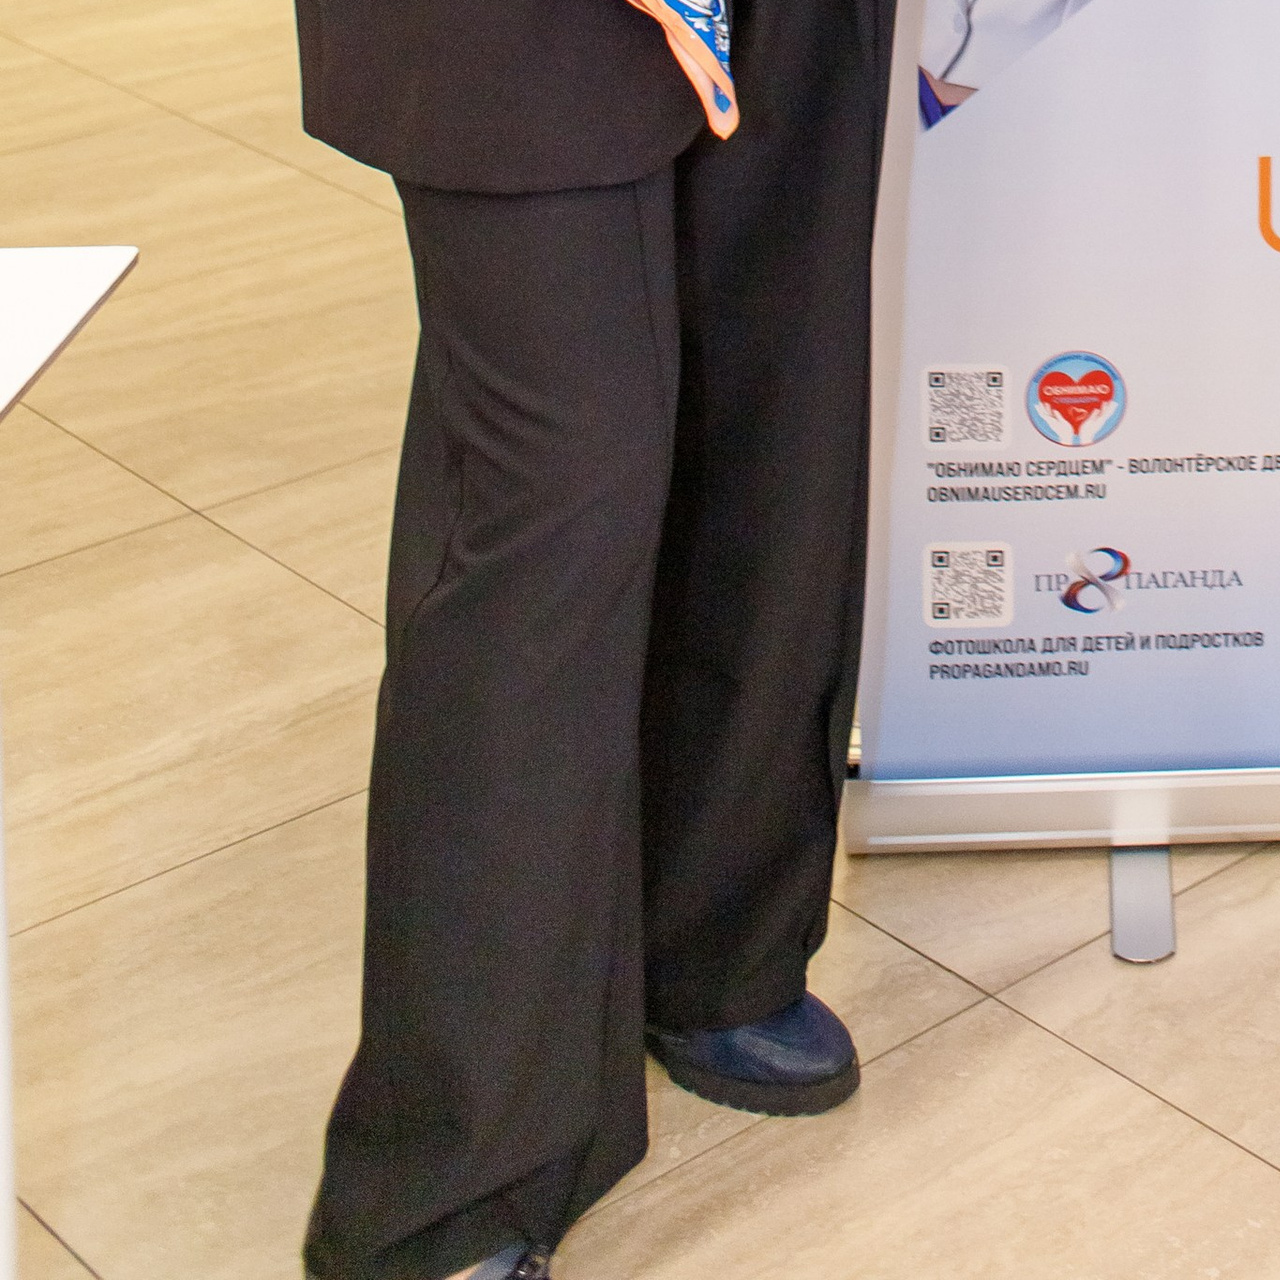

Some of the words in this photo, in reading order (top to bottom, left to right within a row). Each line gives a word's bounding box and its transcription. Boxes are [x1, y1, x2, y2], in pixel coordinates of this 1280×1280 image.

[926, 461, 1021, 479] "ОБНИМАЮ
[1025, 459, 1112, 479] СЕРДЦЕМ"
[1128, 453, 1258, 475] ВОЛОНТЁРСКОЕ
[929, 637, 1037, 657] ФОТОШКОЛА
[1040, 636, 1079, 656] ДЛЯ
[1082, 631, 1137, 654] ДЕТЕЙ
[1139, 635, 1152, 651] И
[1154, 632, 1265, 652] ПОДРОСТКОВ
[929, 661, 1089, 681] PROPAGANDAMO.RU
